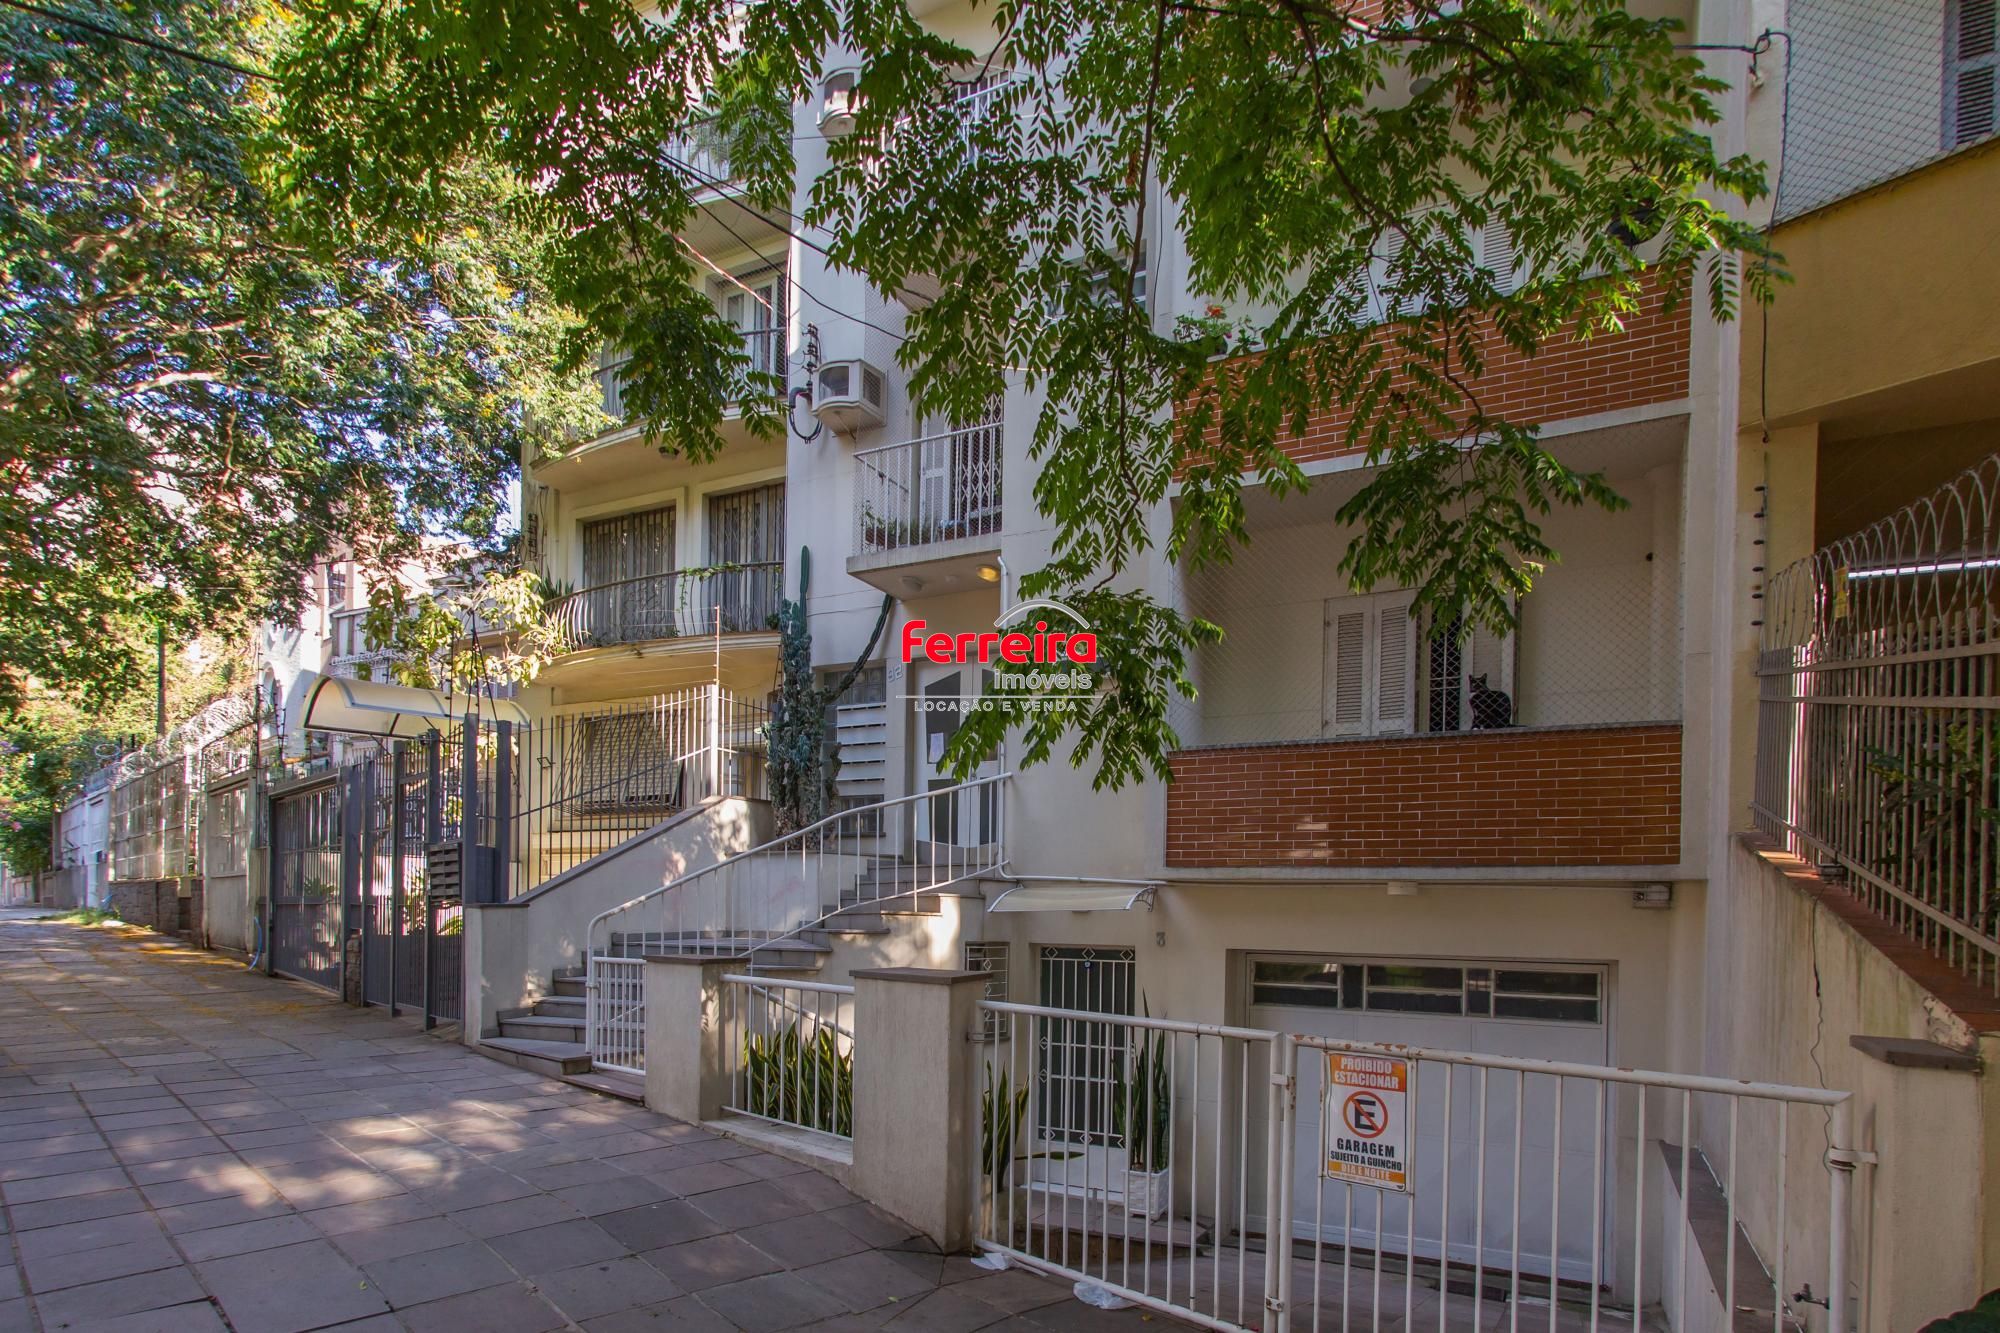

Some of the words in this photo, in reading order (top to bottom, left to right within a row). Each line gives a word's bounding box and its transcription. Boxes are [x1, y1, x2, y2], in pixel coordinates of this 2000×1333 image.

[1341, 1057, 1392, 1074] PROIBIDO
[1334, 1070, 1399, 1089] ESTACIONAR
[1336, 1138, 1395, 1158] GARAGEM
[1330, 1150, 1359, 1164] SUJEITO
[1360, 1156, 1366, 1165] A
[1367, 1156, 1402, 1171] GUINCHO
[1341, 1164, 1356, 1174] DIA
[1358, 1166, 1363, 1176] E
[1364, 1167, 1390, 1180] NOITE
